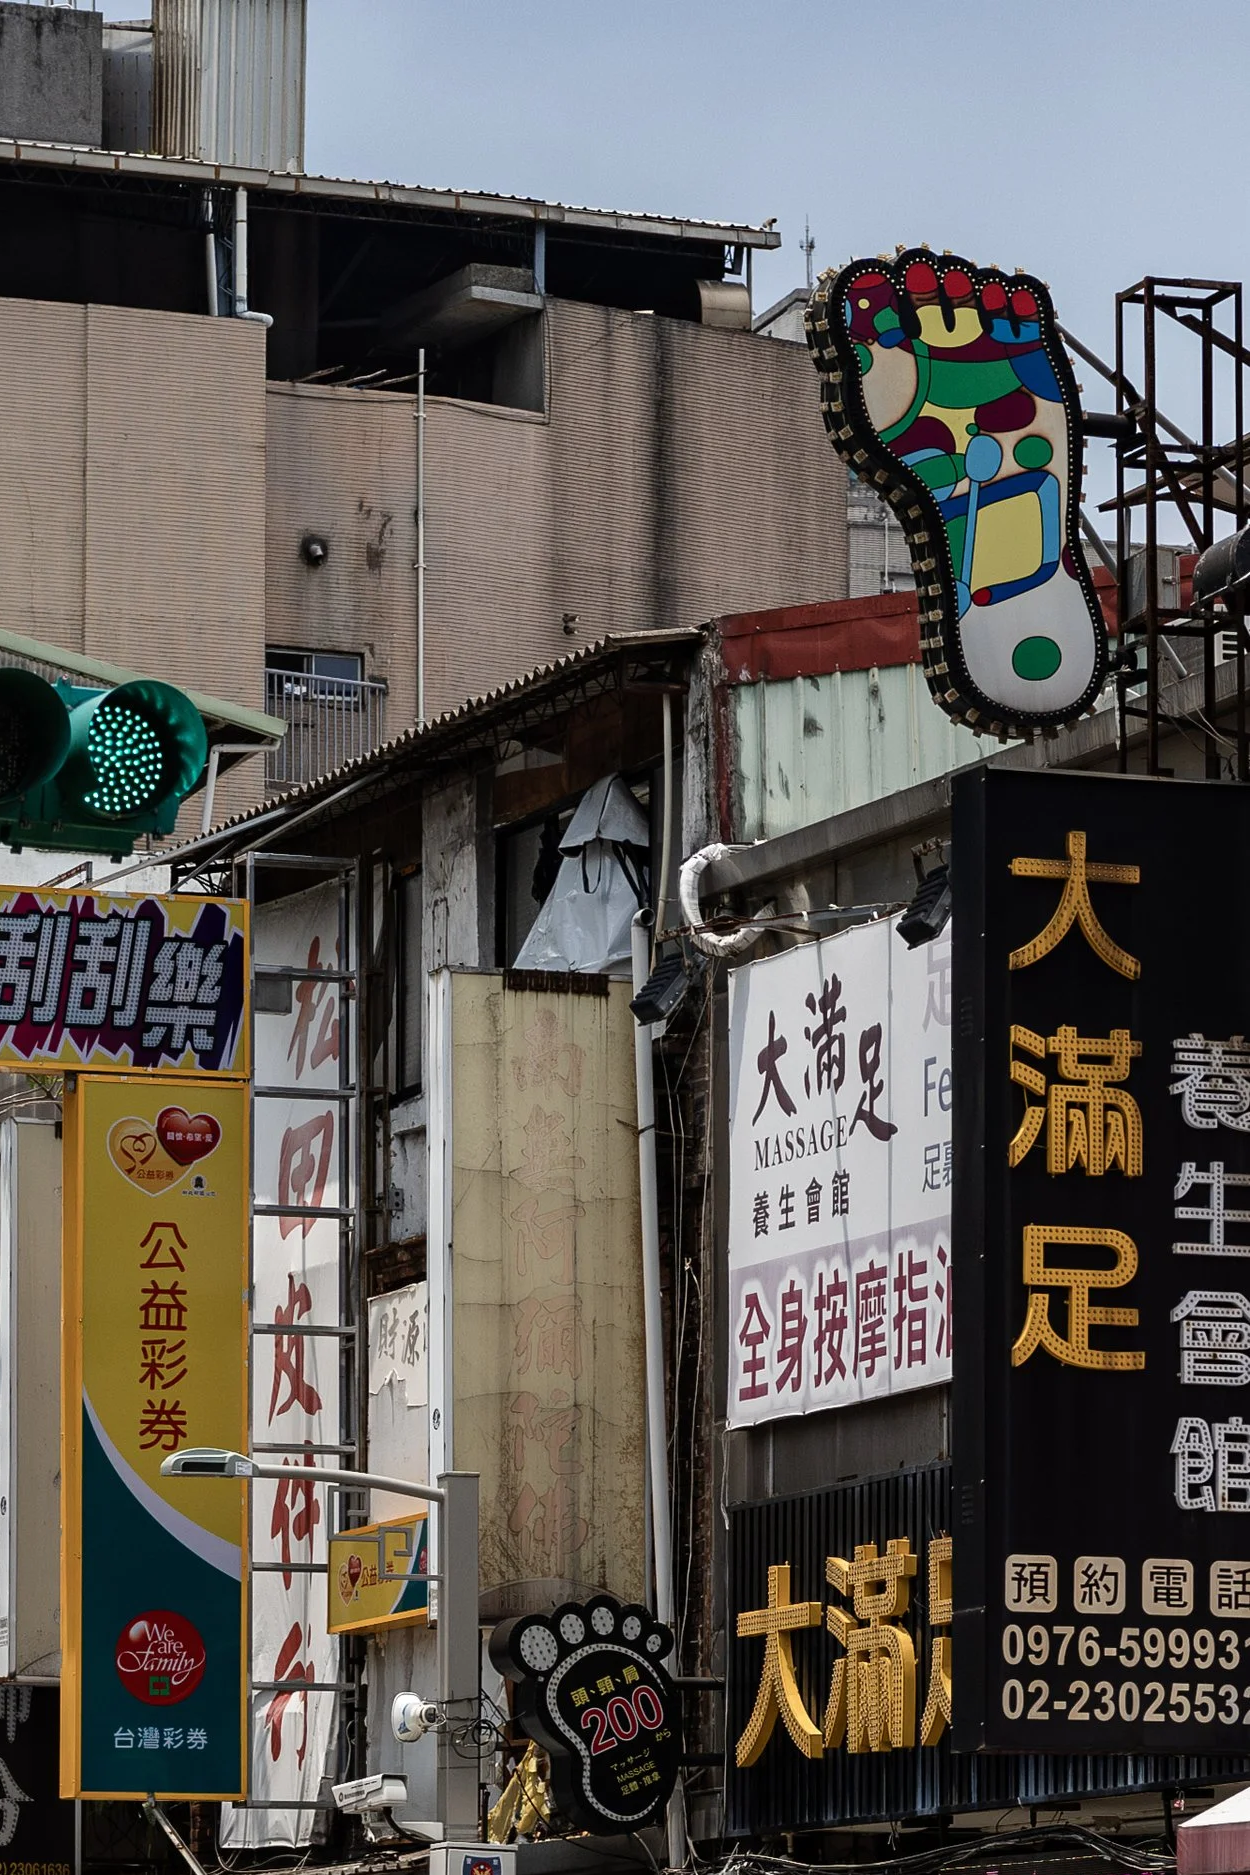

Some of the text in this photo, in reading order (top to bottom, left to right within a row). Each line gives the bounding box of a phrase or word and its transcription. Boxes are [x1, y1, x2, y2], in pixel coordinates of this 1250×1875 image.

[753, 972, 897, 1143] 大滿足
[922, 1055, 952, 1118] Fe
[1007, 829, 1147, 1371] 大滿足
[753, 1114, 848, 1172] MASSAGE
[752, 1168, 851, 1240] 養生會館
[1169, 1031, 1250, 1513] 養生會館
[138, 1221, 189, 1452] 公益彩券
[377, 1304, 430, 1368] 財源
[1011, 1562, 1250, 1611] 預約電話
[143, 1622, 175, 1642] We
[156, 1640, 184, 1655] are
[1002, 1624, 1250, 1672] 0976-59993
[113, 1725, 209, 1750] 台灣彩券
[580, 1684, 665, 1757] 200
[615, 1759, 657, 1785] MASSAGE
